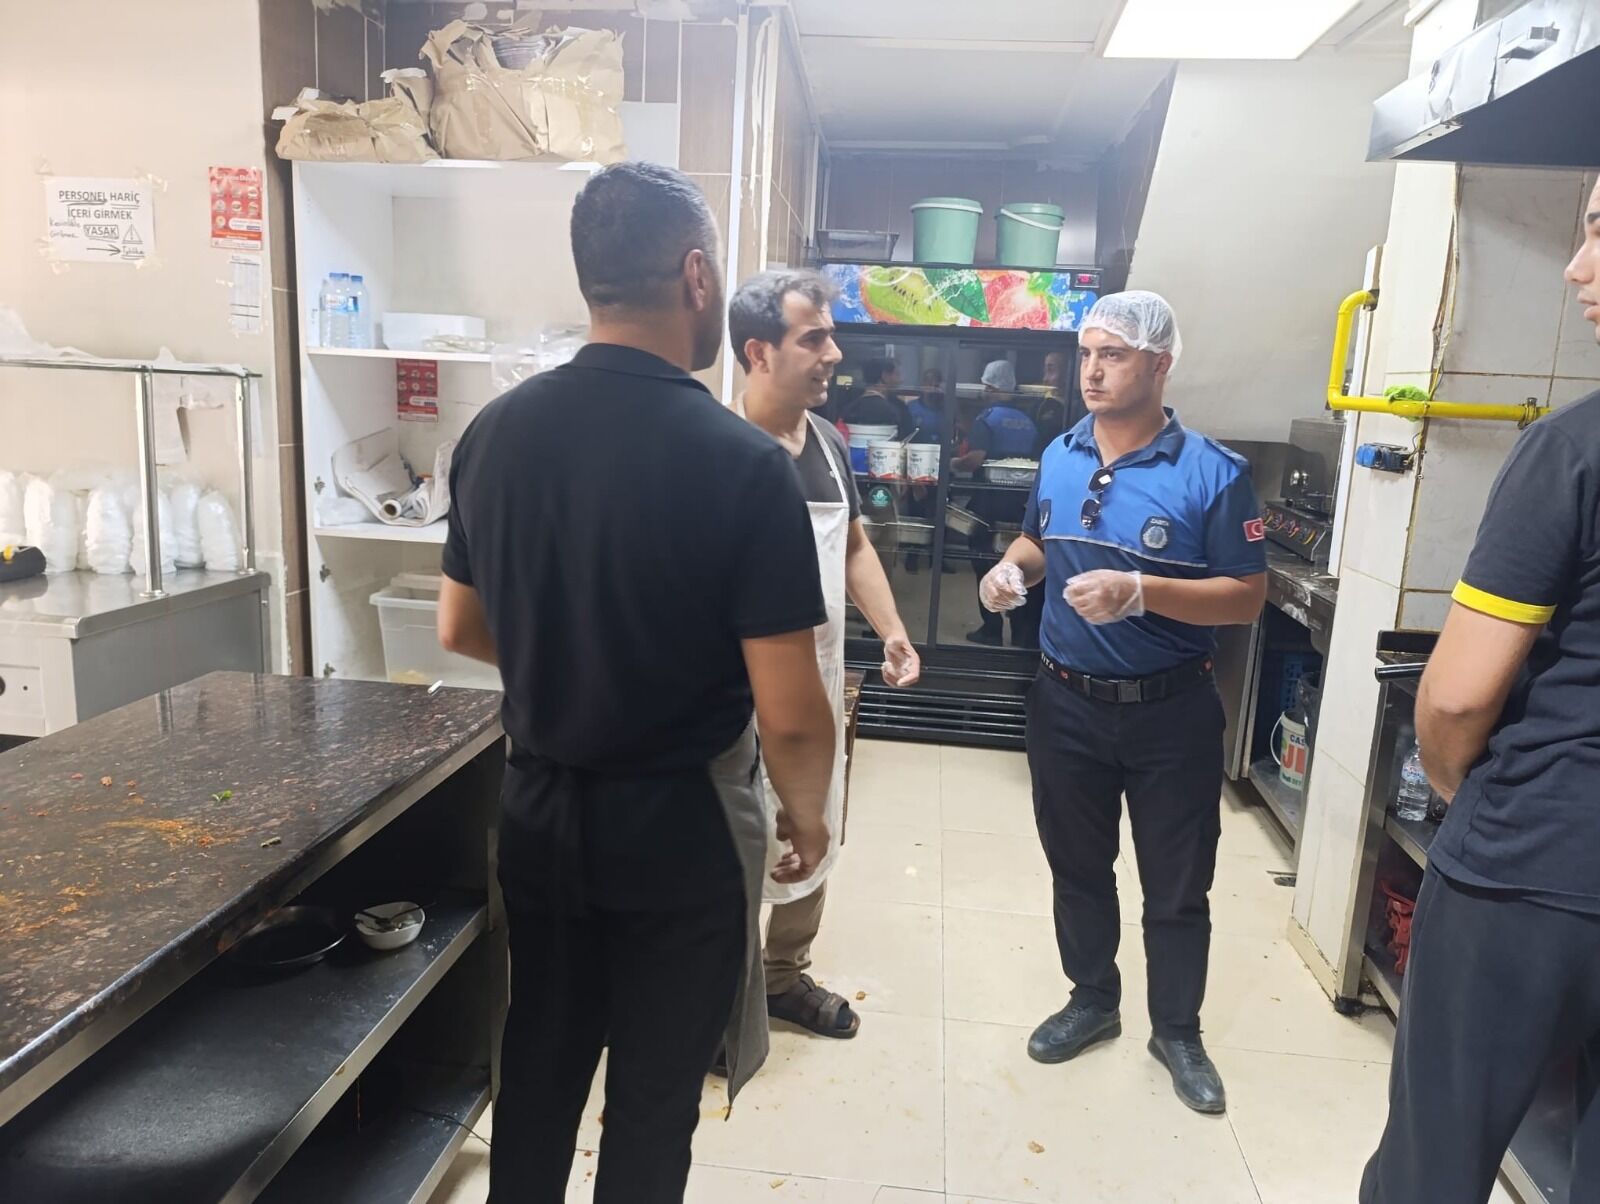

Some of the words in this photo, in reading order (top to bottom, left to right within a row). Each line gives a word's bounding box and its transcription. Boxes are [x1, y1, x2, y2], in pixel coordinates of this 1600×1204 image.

[59, 190, 107, 201] PERSONEL
[110, 191, 140, 203] HARİÇ
[67, 206, 91, 219] İÇERİ
[94, 208, 133, 220] GİRMEK
[85, 226, 117, 236] YASAK
